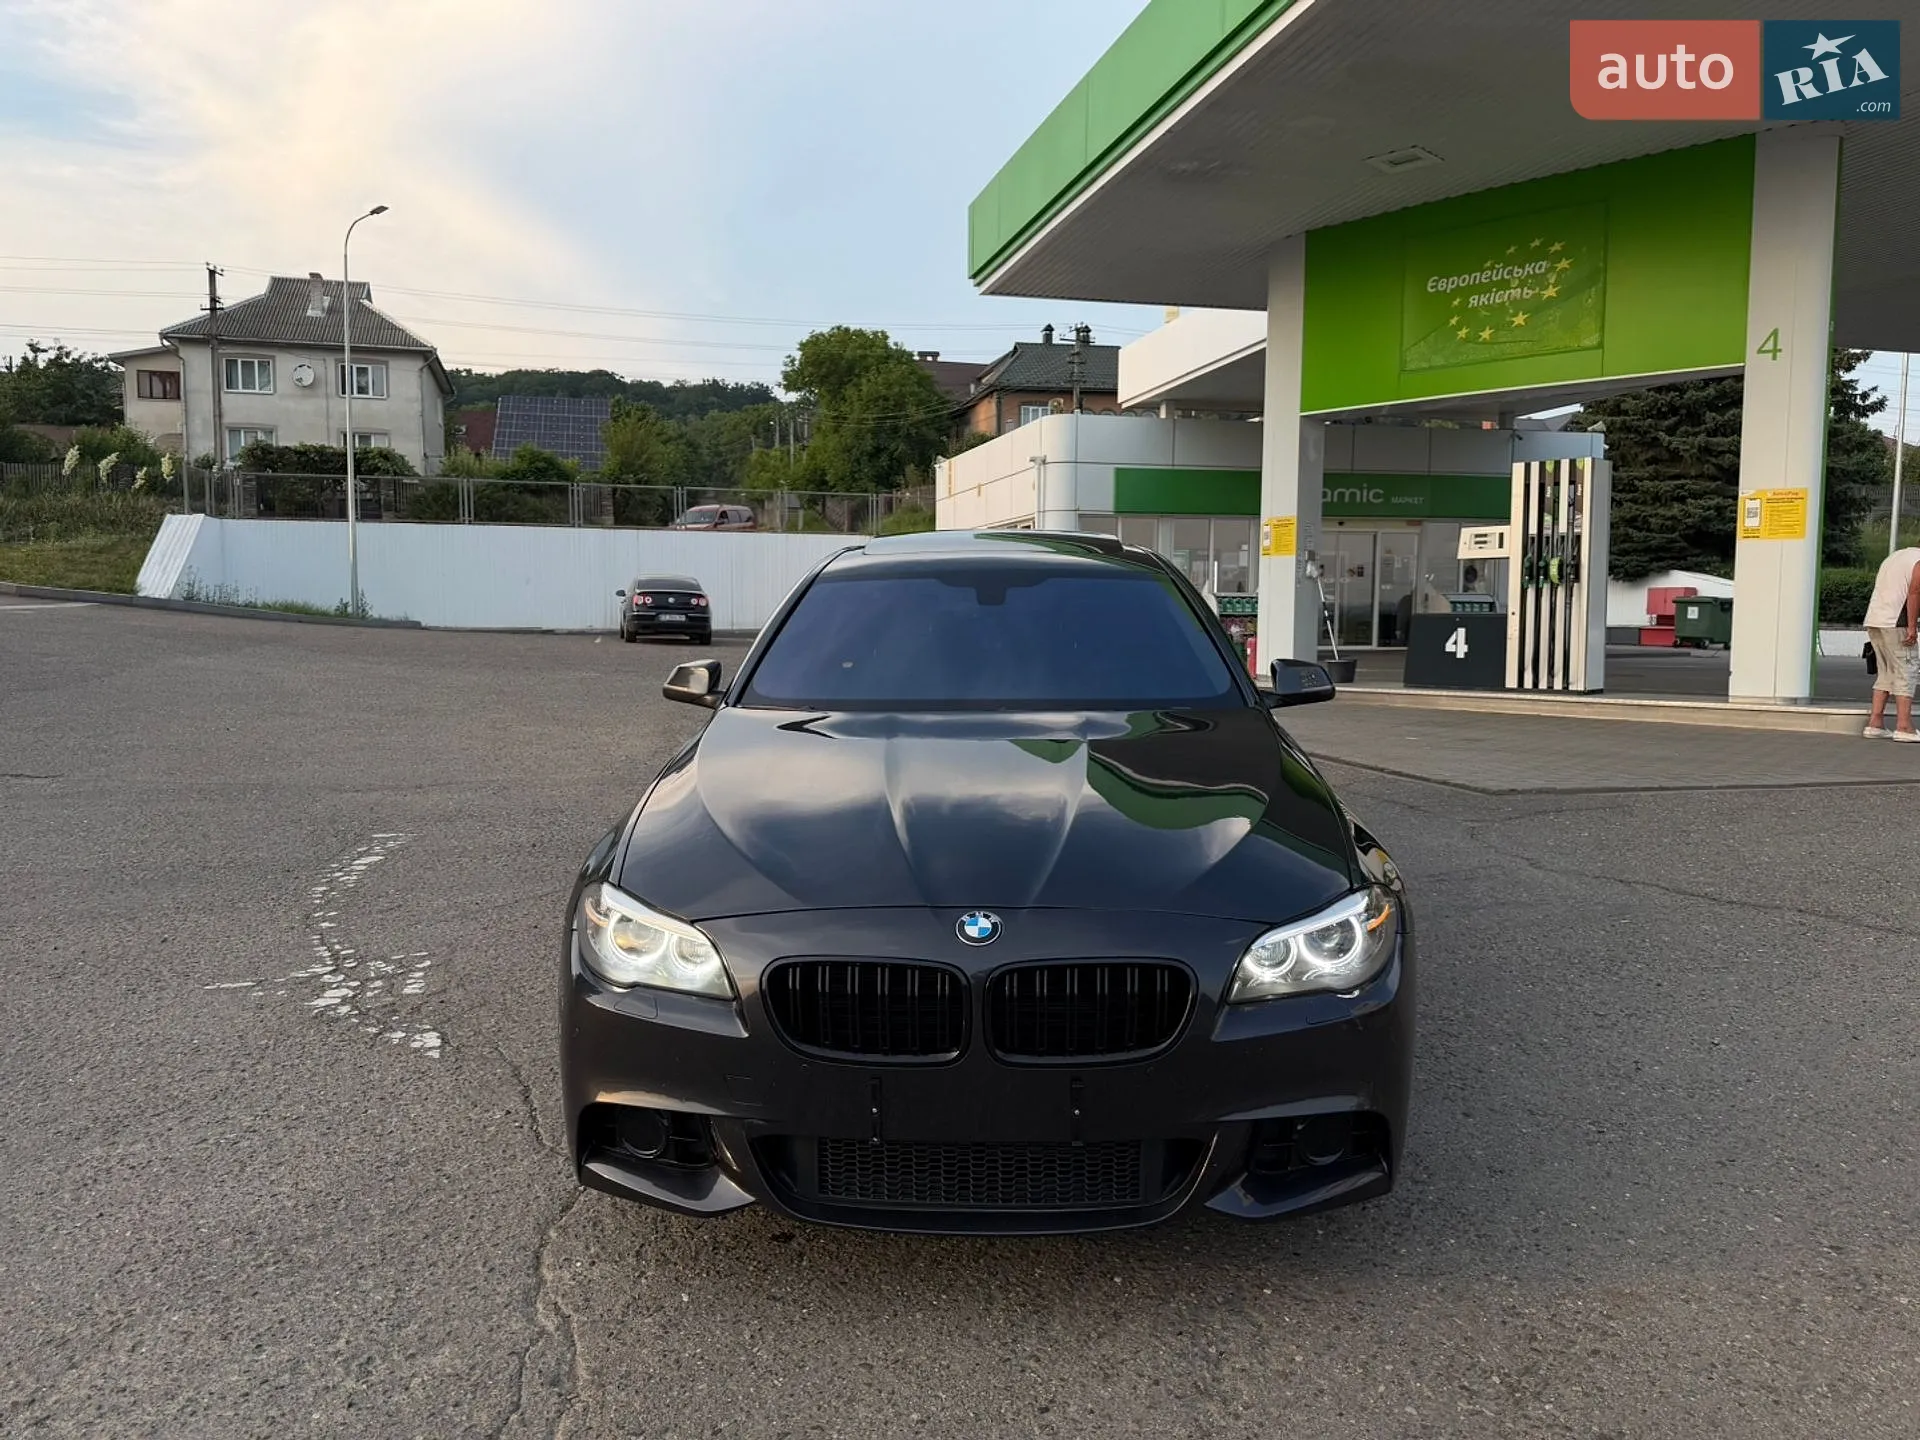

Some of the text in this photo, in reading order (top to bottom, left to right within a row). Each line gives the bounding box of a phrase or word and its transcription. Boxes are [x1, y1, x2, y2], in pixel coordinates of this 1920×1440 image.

[1426, 260, 1548, 294] Європейська
[1467, 284, 1534, 309] якість
[1756, 327, 1782, 361] 4
[1445, 627, 1469, 659] 4
